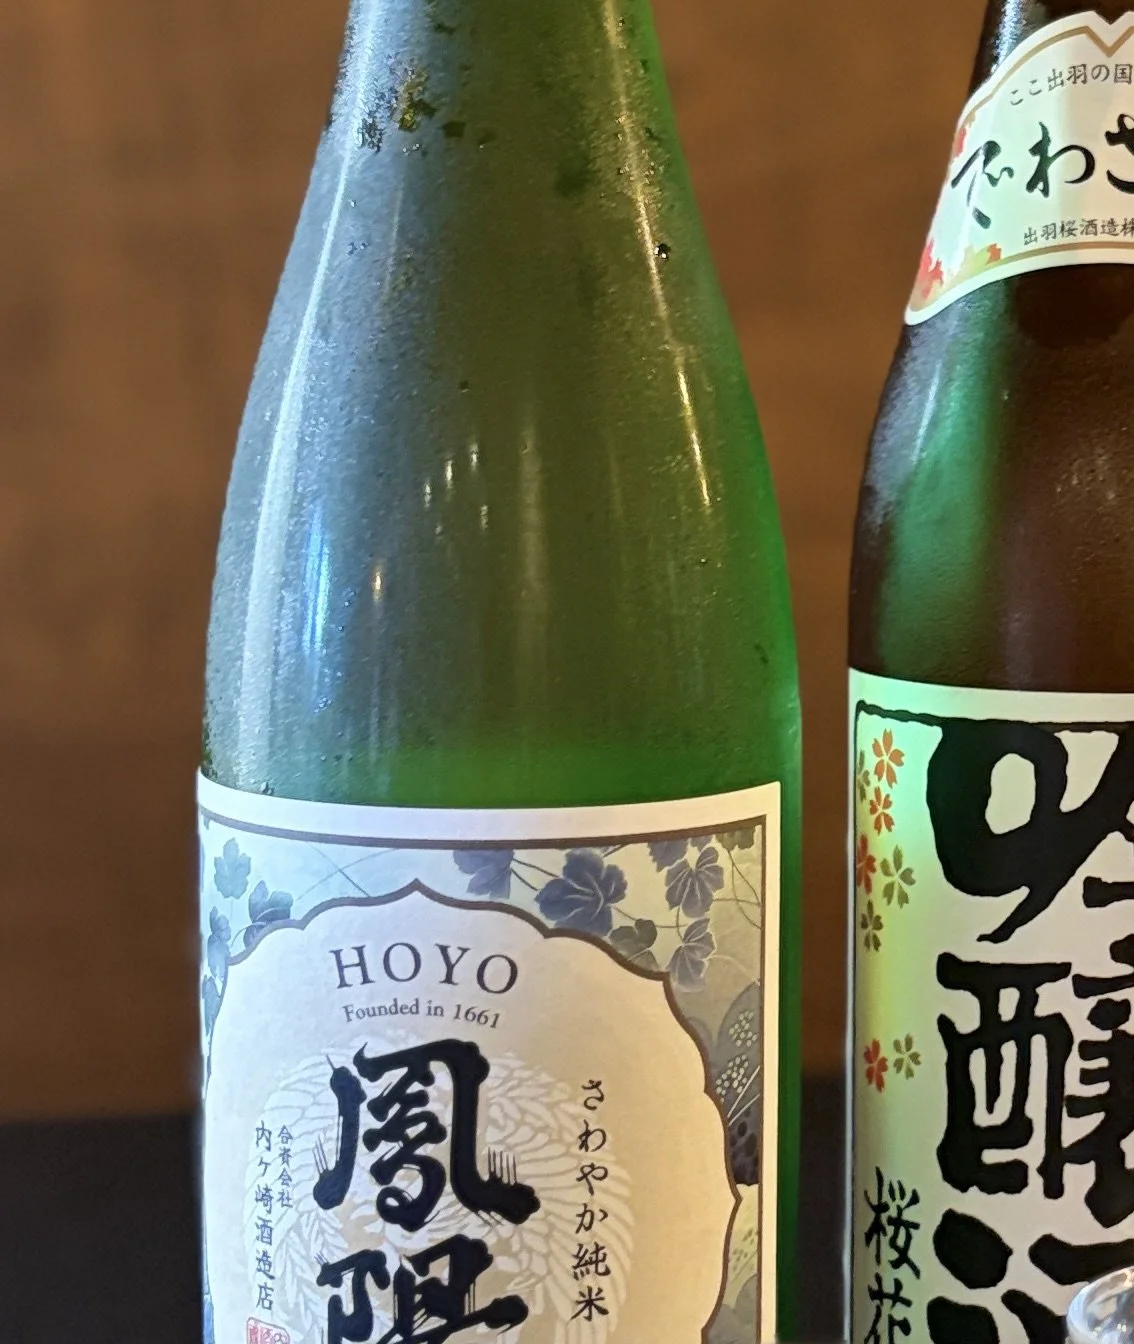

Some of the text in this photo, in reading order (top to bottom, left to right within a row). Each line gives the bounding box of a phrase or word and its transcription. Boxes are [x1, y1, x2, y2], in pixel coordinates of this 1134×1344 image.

[329, 942, 519, 995] HOYO
[343, 998, 501, 1029] Founded in 1661
[277, 1124, 294, 1209] 合資会社
[570, 1079, 612, 1323] さわやか純米
